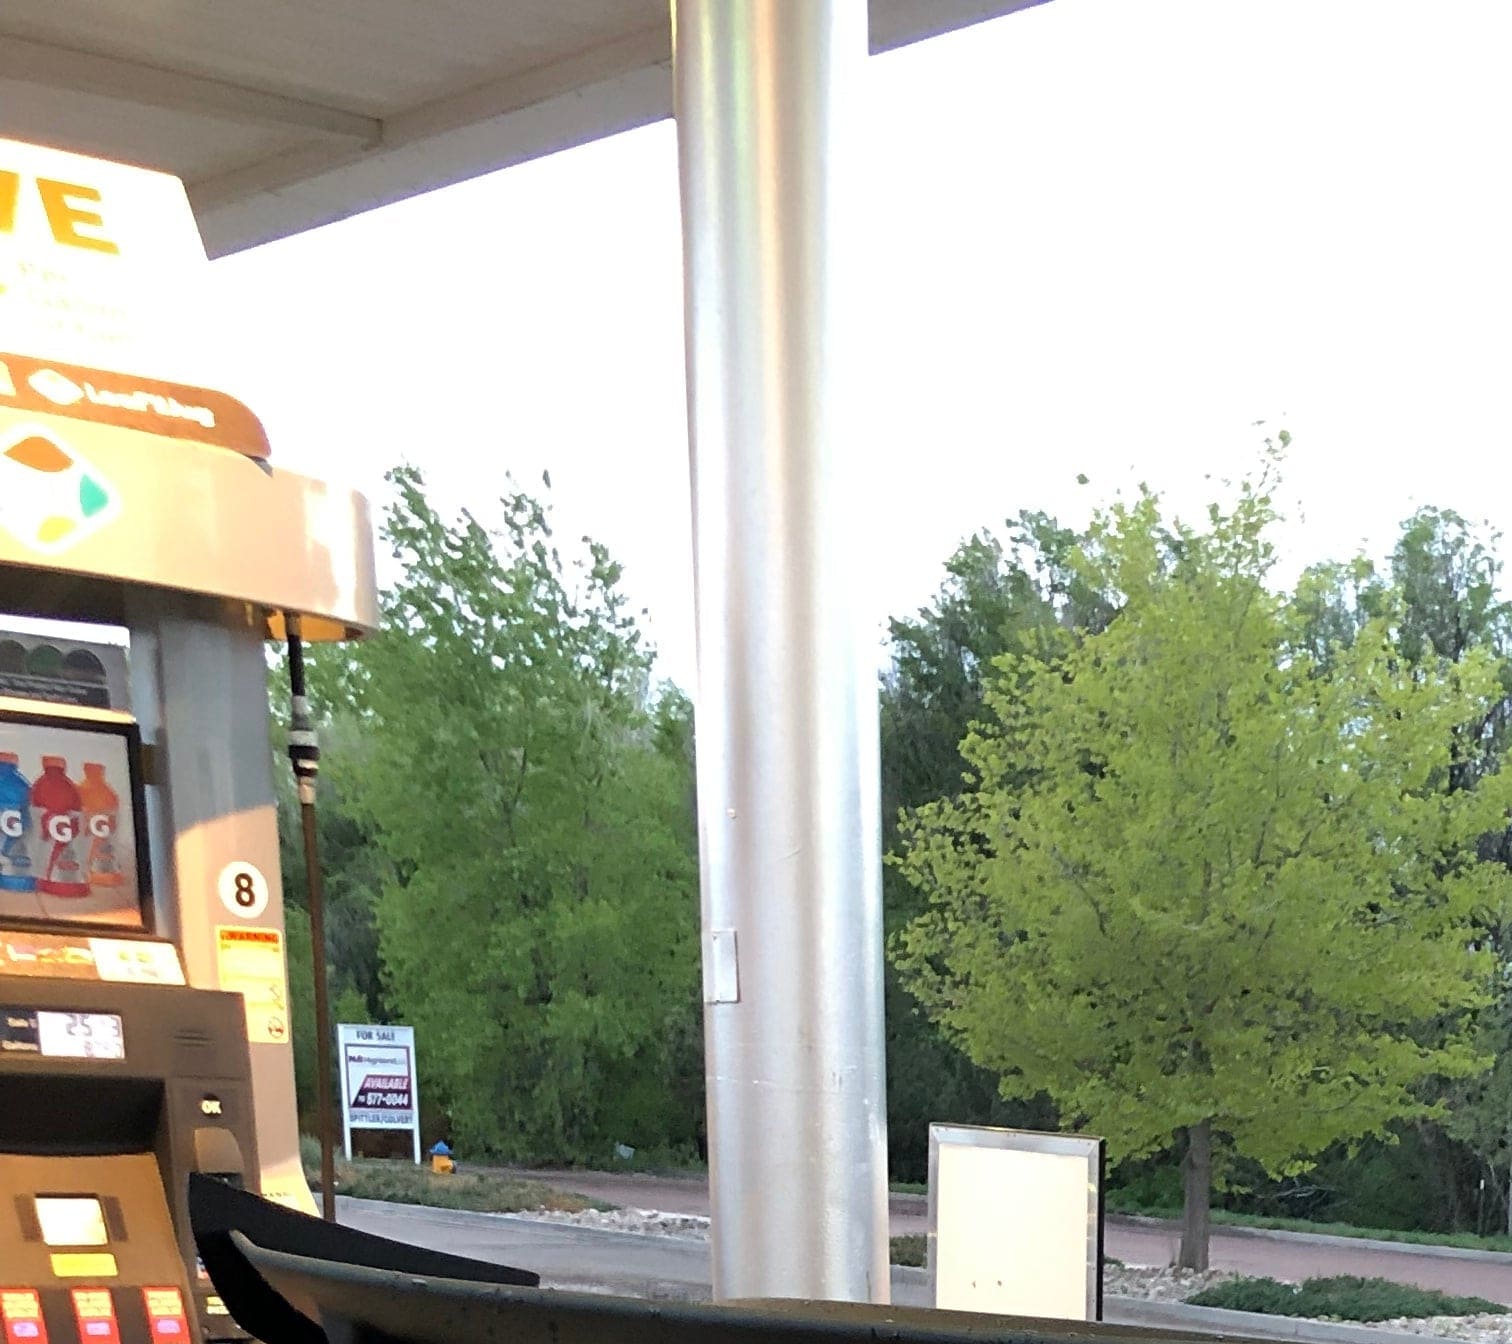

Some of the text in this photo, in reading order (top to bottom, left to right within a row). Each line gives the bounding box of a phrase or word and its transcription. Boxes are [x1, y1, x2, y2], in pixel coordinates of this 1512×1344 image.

[1, 809, 23, 838] G
[49, 815, 72, 842] G
[90, 814, 110, 838] G
[235, 873, 256, 907] 8
[356, 1030, 395, 1041] FOR SALE
[363, 1077, 409, 1090] AVAILABLE
[201, 1099, 222, 1114] OK
